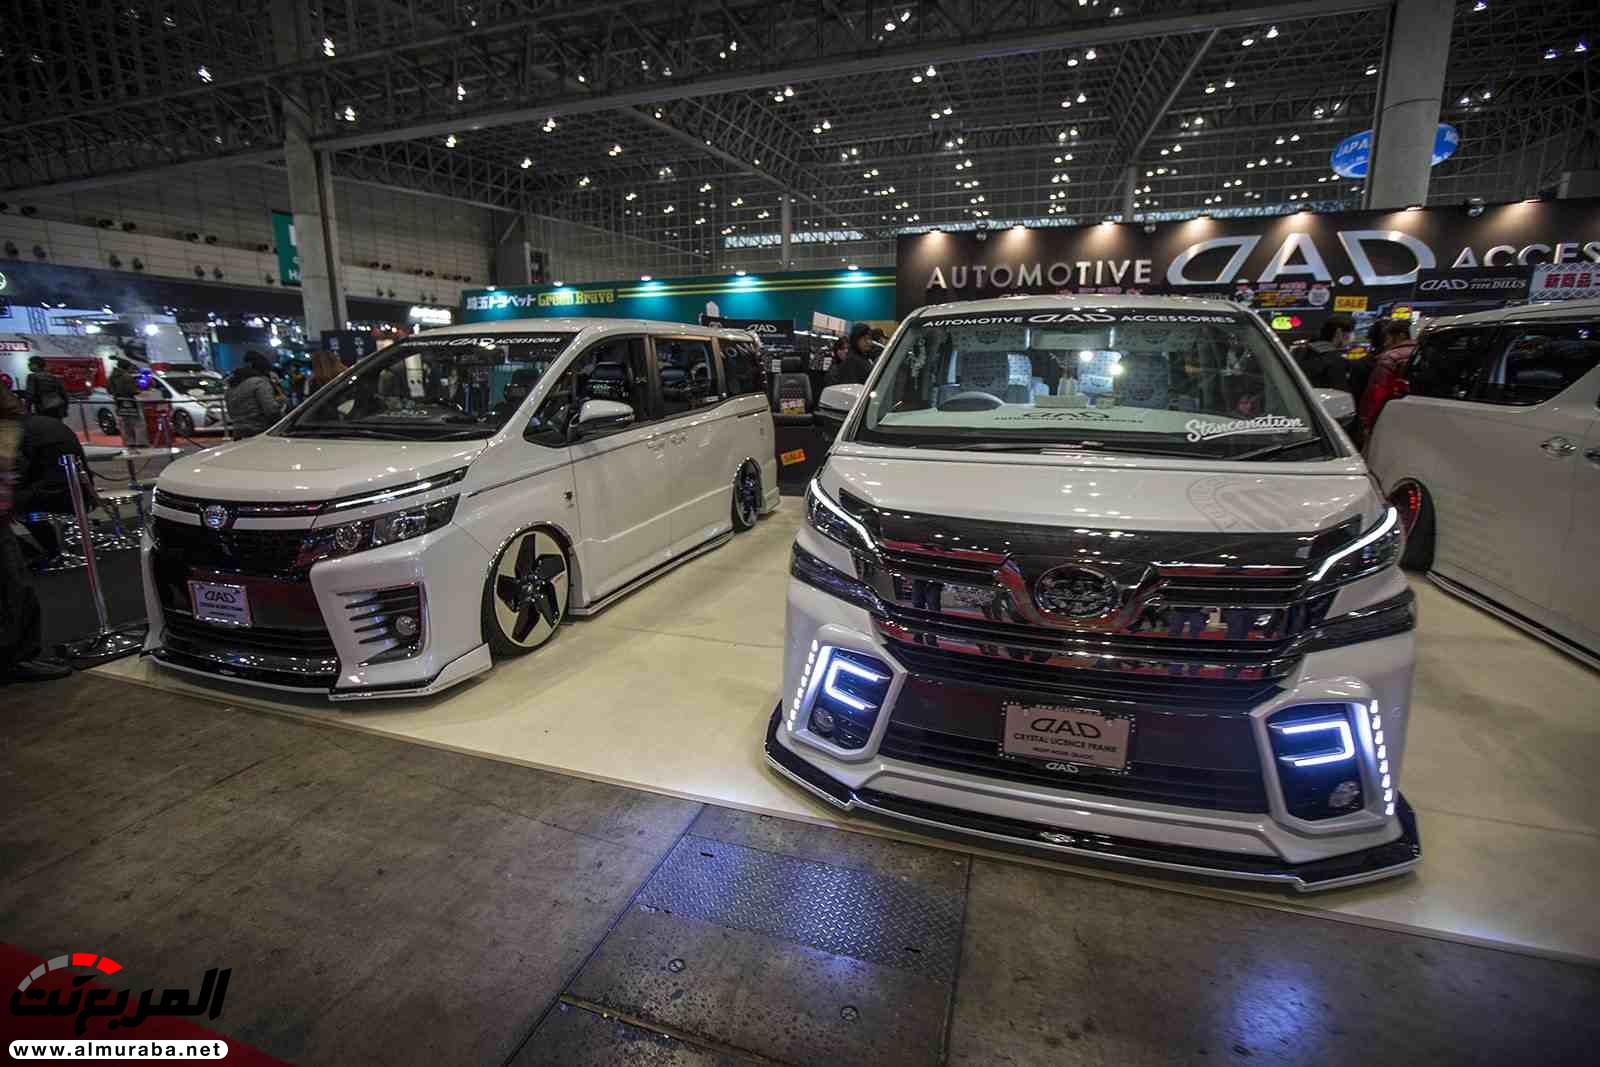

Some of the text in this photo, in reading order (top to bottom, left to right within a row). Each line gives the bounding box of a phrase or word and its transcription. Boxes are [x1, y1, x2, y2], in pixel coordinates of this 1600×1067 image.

[1335, 138, 1369, 158] JAPA
[926, 259, 1153, 289] AUTOMOTIVE
[538, 292, 573, 307] Green
[575, 289, 614, 305] Brave
[922, 316, 1024, 328] AUTOMOTIVE
[1121, 315, 1236, 325] ACCESSORIES
[1184, 414, 1304, 442] Stancenation
[1014, 732, 1049, 744] CRYSTAL
[1088, 743, 1118, 753] FRAME
